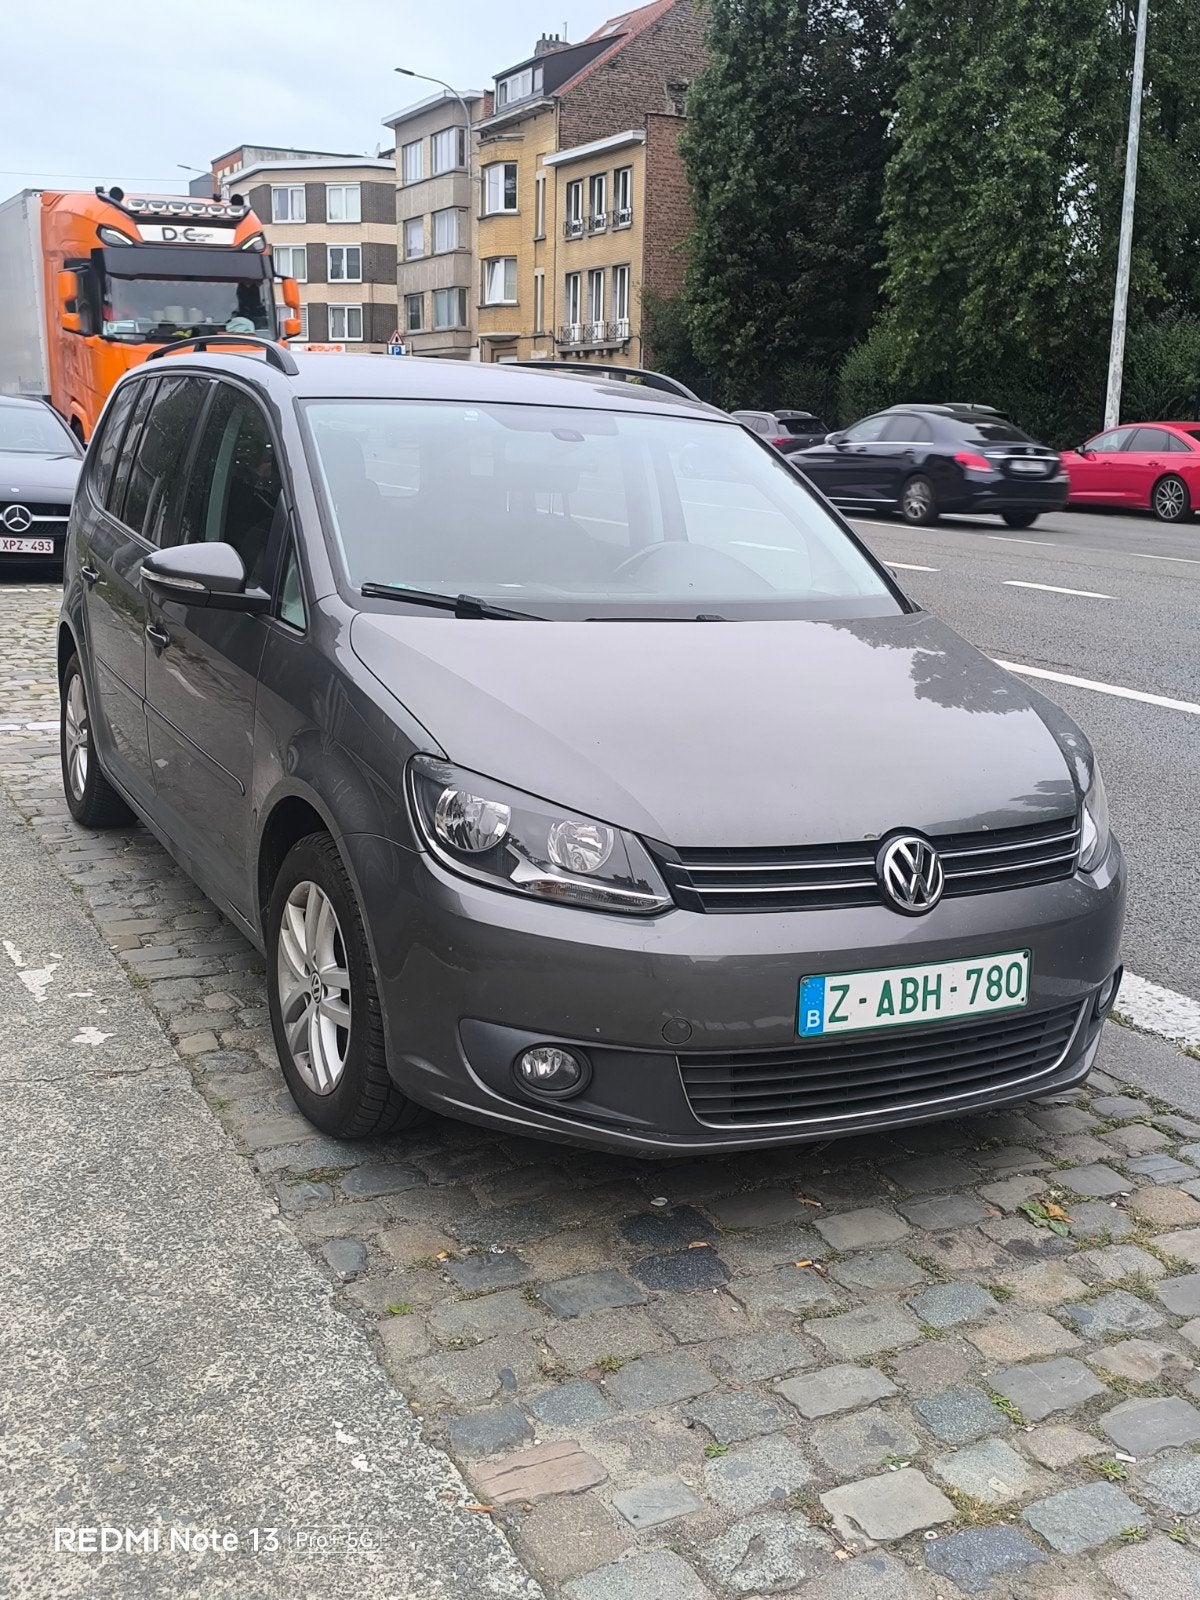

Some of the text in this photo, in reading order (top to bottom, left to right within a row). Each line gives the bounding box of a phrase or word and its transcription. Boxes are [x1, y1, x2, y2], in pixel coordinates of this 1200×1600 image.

[2, 540, 52, 551] XPZ-493
[806, 961, 1023, 1028] B Z-ABH-780
